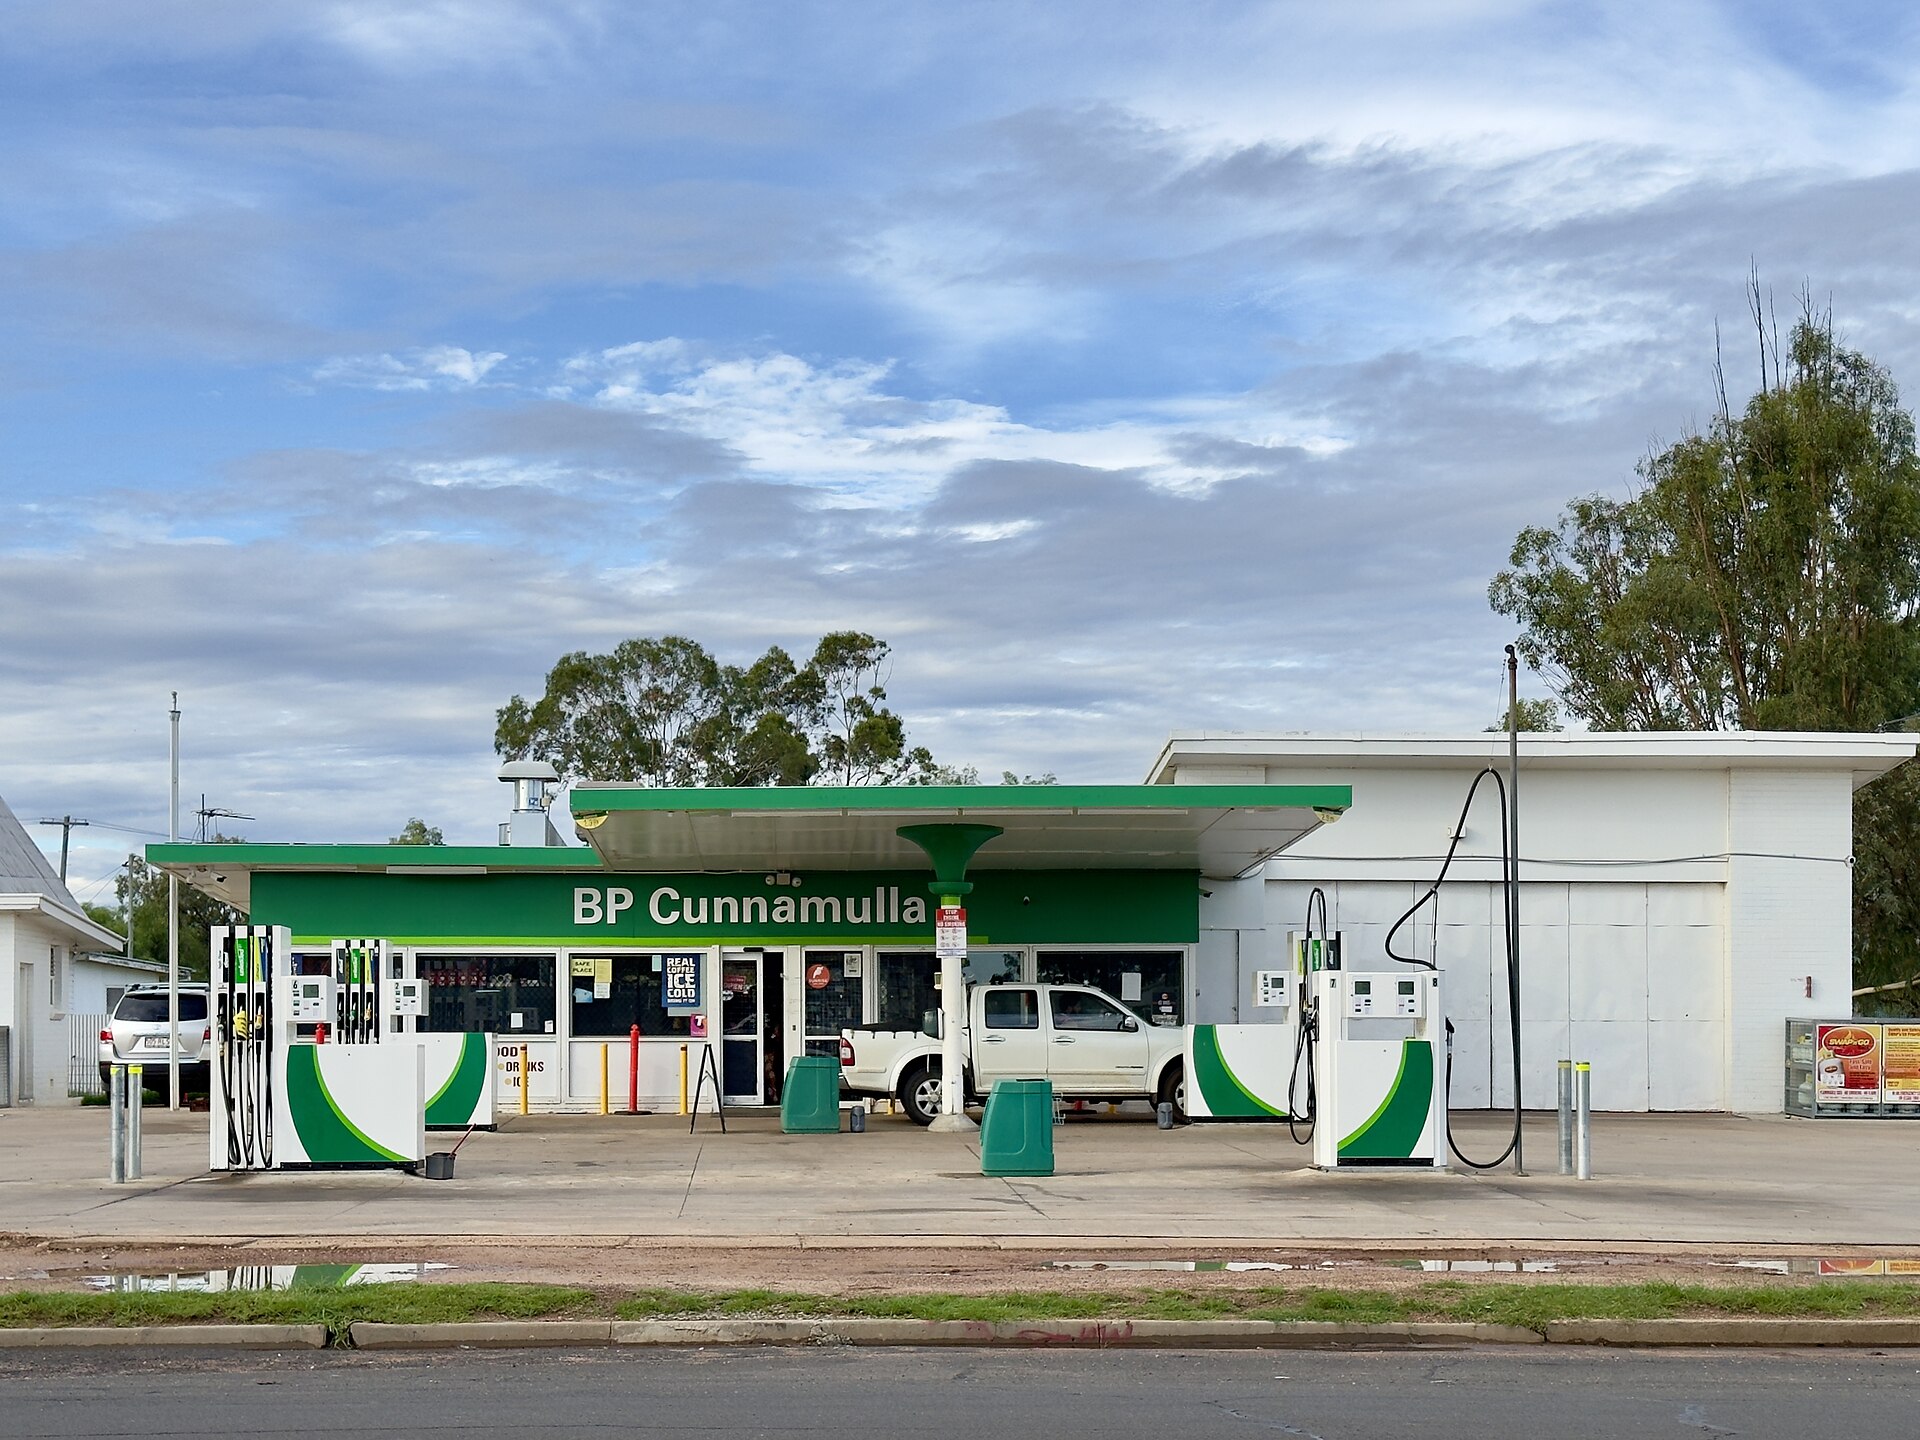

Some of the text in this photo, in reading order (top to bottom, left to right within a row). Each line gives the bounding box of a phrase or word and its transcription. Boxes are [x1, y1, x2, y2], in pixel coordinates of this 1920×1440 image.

[573, 886, 926, 925] BP Cunnamulla
[666, 957, 696, 967] REAL
[666, 966, 695, 974] COFFEE
[292, 980, 298, 989] 6
[666, 973, 696, 989] ICE
[1330, 978, 1336, 988] 7
[1432, 978, 1438, 987] 8
[666, 988, 696, 998] COLD
[695, 1015, 706, 1027] T
[497, 1046, 518, 1057] OD
[506, 1061, 544, 1072] DRKS
